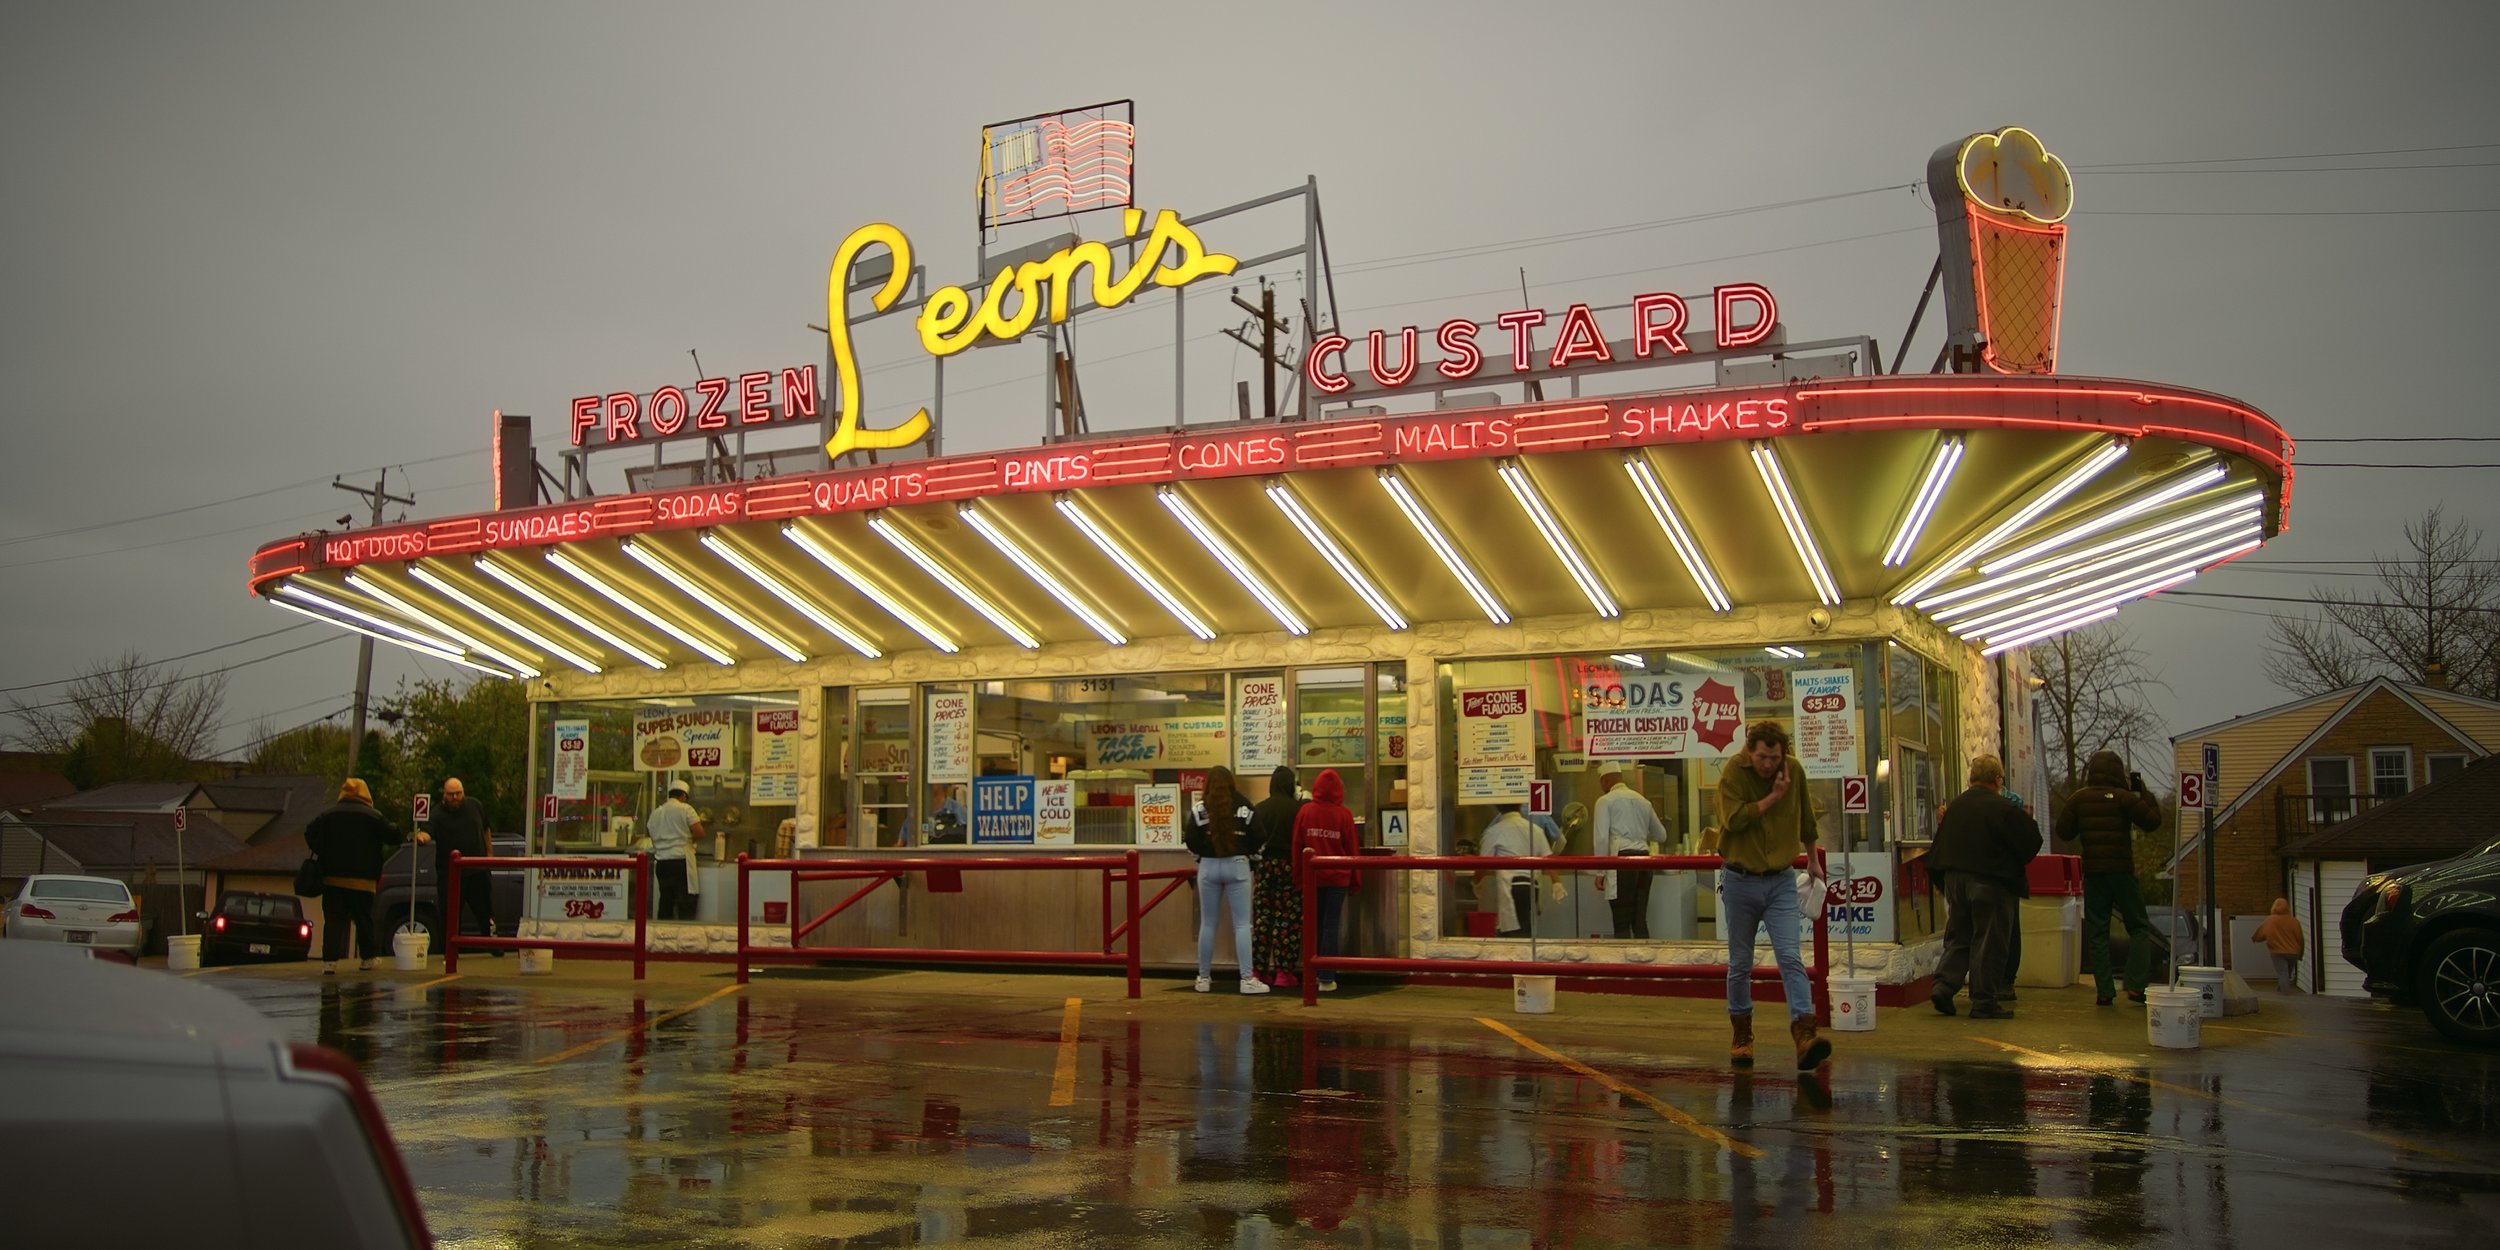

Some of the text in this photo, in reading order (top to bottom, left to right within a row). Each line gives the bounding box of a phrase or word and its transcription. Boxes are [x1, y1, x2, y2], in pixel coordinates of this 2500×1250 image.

[825, 208, 1239, 460] Leon's
[1306, 283, 1779, 393] CUSTARD
[571, 365, 817, 446] FROZEN
[1617, 398, 1790, 438] SHAKES
[1393, 419, 1513, 455] MALTS
[1178, 437, 1286, 470] CONES
[1004, 455, 1090, 486] PINTS
[814, 473, 923, 511] QUARTS
[657, 493, 741, 521] SODAS
[485, 511, 593, 544] SUNDAES
[326, 532, 427, 562] HOT DOGS
[1081, 679, 1115, 692] 3131
[1244, 683, 1275, 694] CONE
[1795, 678, 1819, 687] MALTS
[1824, 676, 1850, 685] SHAKES
[1806, 685, 1841, 695] FLAVORS
[935, 699, 964, 709] CONE
[1242, 694, 1278, 708] PRICES
[1486, 692, 1518, 704] CONE
[1587, 681, 1684, 709] SODAS
[1807, 698, 1840, 710] $5.50
[643, 708, 672, 719] LEON'S
[772, 712, 794, 721] CONE
[934, 708, 967, 722] PRICES
[1482, 703, 1524, 716] FLAVORS
[637, 710, 731, 737] SUPER SUNDAE
[770, 719, 798, 730] FLAVORS
[1091, 723, 1125, 734] LEON'S
[1164, 721, 1224, 730] THE CUSTARD
[1587, 716, 1689, 734] FROZEN CUSTARD
[683, 728, 722, 745] Special
[1096, 734, 1145, 751] TAKE
[1098, 745, 1157, 765] HOME
[979, 785, 1029, 811] HELP
[1535, 785, 1546, 811] 1
[1846, 779, 1865, 809] 2
[2183, 775, 2201, 805] 3
[417, 798, 427, 818] 2
[547, 798, 555, 817] 1
[1047, 797, 1065, 806] ICE
[1142, 805, 1175, 815] GRILLED
[175, 810, 185, 828] 3
[1040, 808, 1071, 820] COLD
[1143, 815, 1171, 825] CHEESE
[977, 815, 1033, 837] WANTED
[1388, 815, 1403, 834] A
[1829, 877, 1877, 901] $5.50
